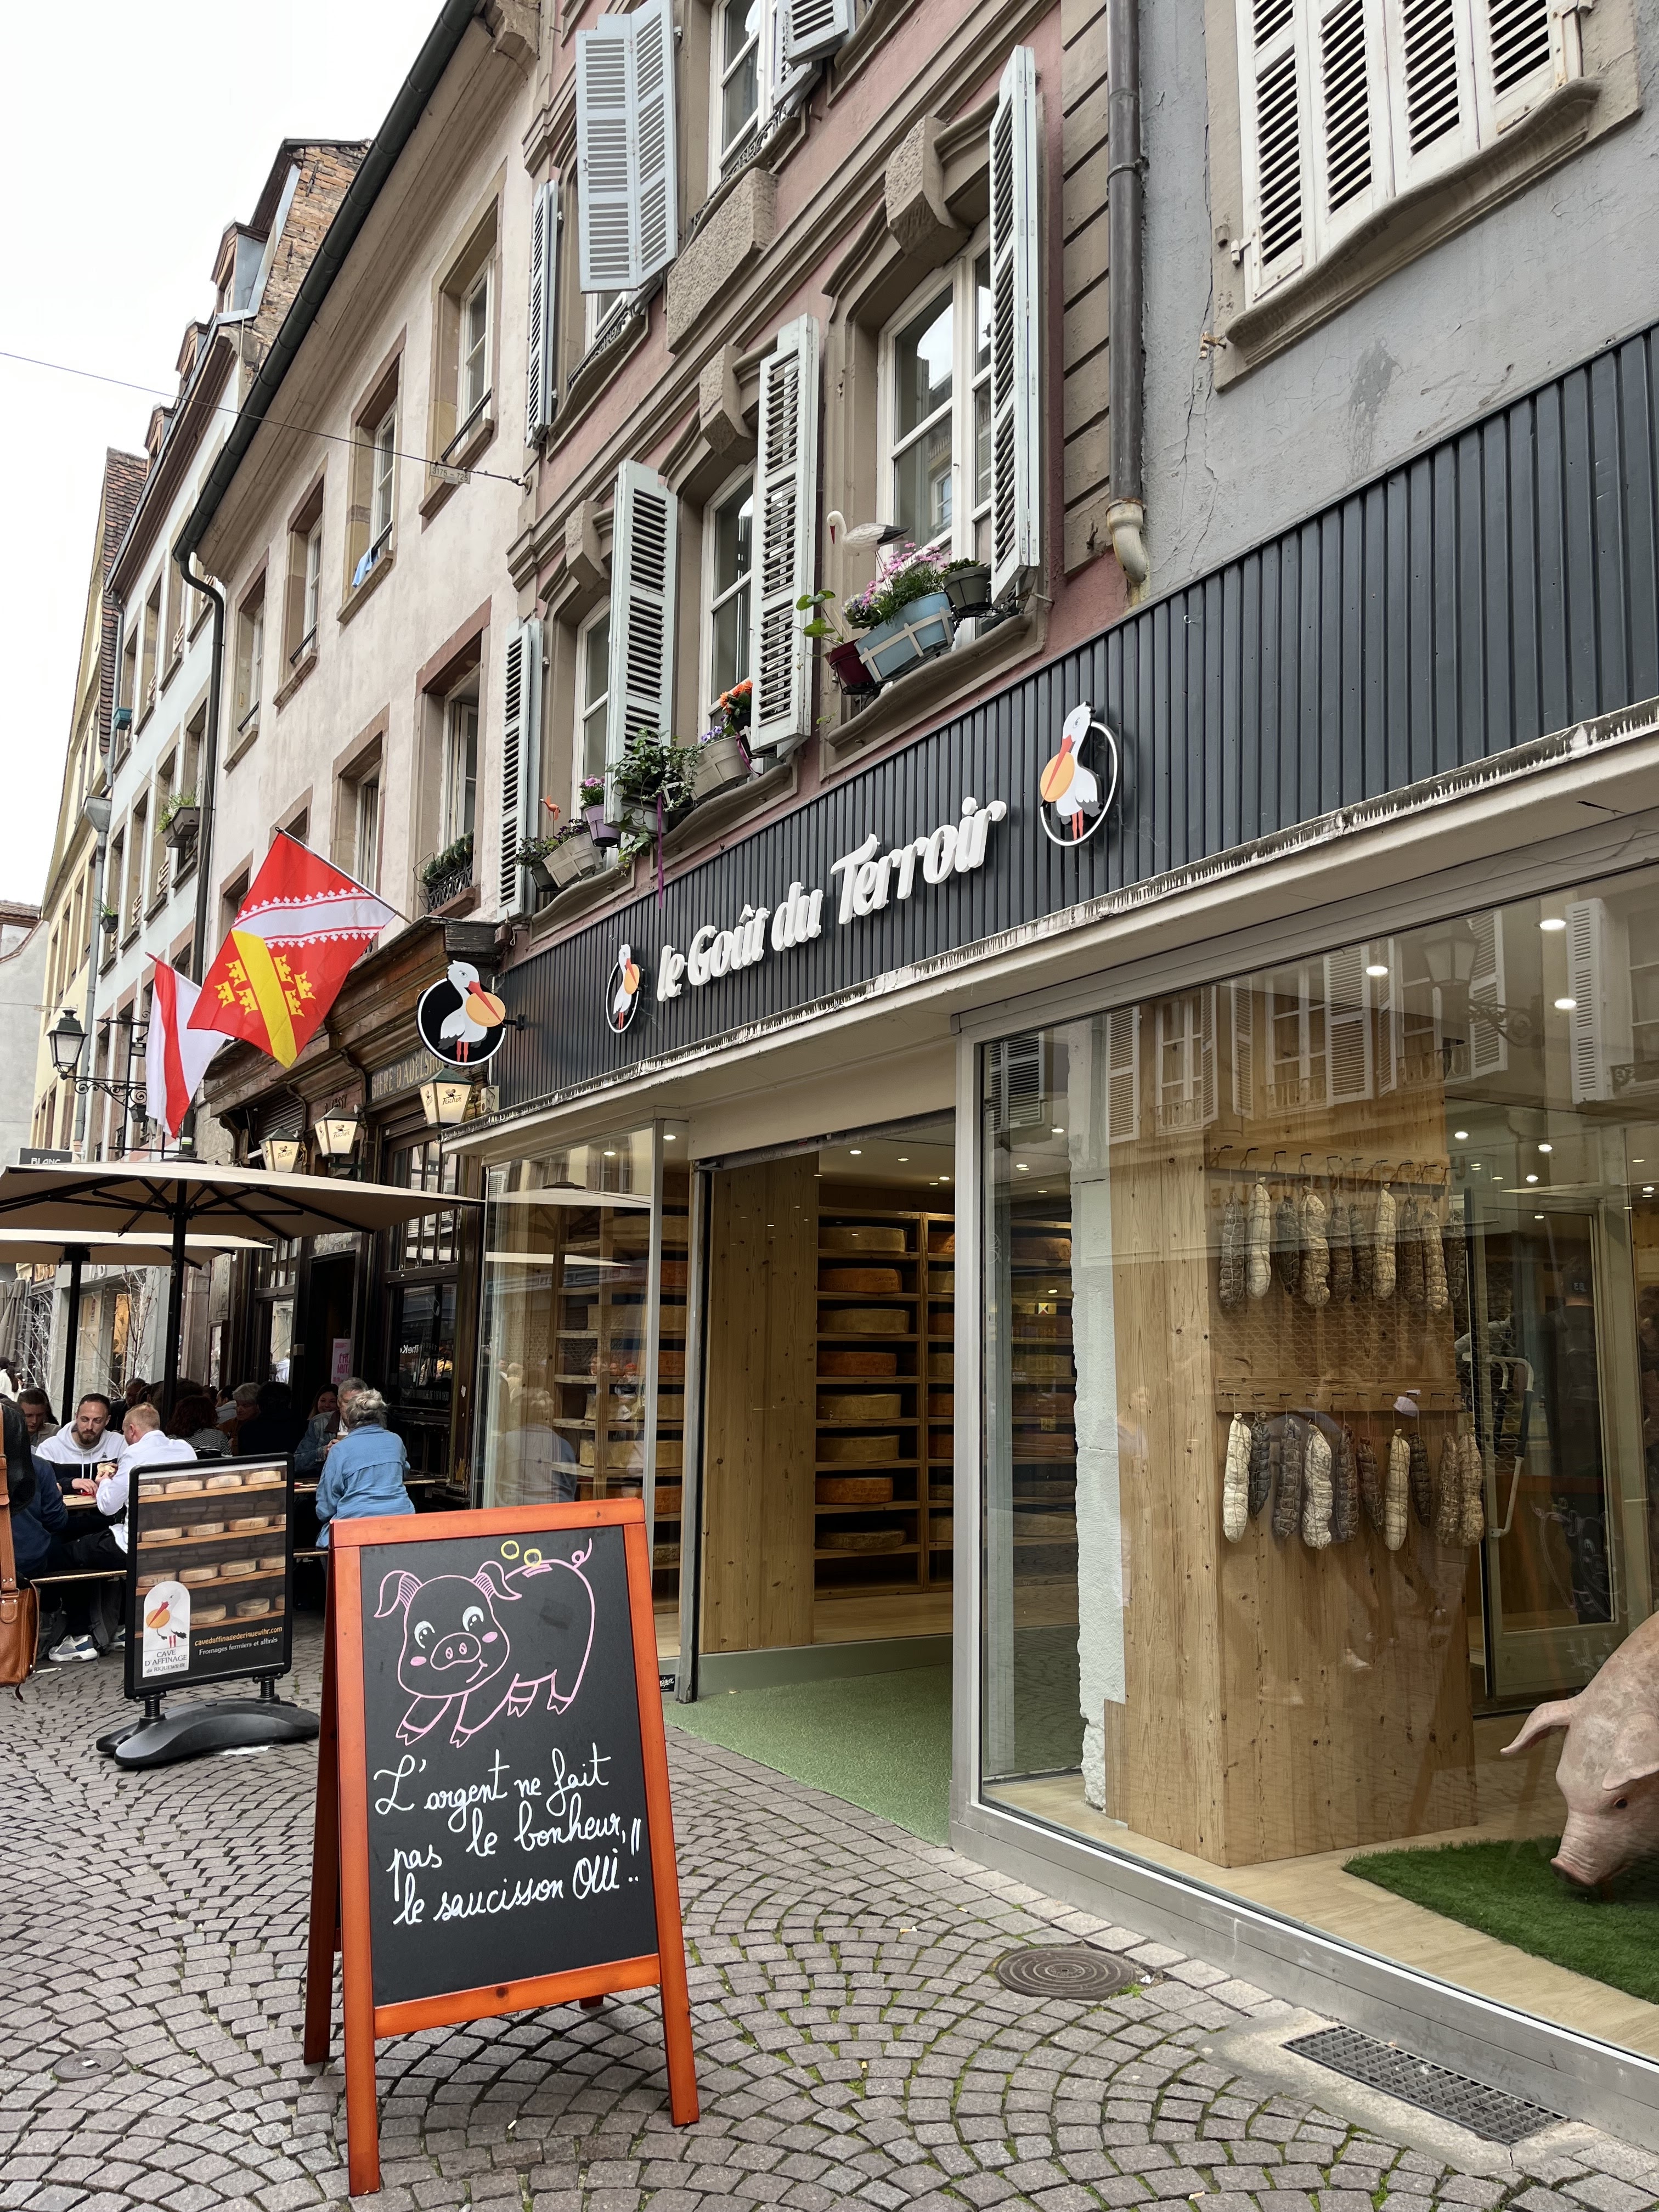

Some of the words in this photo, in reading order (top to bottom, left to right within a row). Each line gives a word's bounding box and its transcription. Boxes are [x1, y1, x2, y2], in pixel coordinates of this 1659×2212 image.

[656, 944, 687, 1002] le
[687, 904, 770, 986] Goût
[771, 881, 824, 952] du
[830, 796, 1008, 925] Terroir
[396, 1048, 445, 1089] D'ADELSHO
[443, 1096, 462, 1105] Fischer
[144, 1654, 188, 1667] D'AFFINAGE
[156, 1649, 177, 1658] CAVE
[199, 1646, 228, 1656] Fromages
[228, 1641, 252, 1651] fermiers
[514, 1777, 541, 1797] ne
[546, 1742, 611, 1817] fait
[386, 1843, 443, 1902] pas
[465, 1807, 498, 1857] le
[393, 1872, 425, 1925] le
[433, 1878, 563, 1921] saucisson
